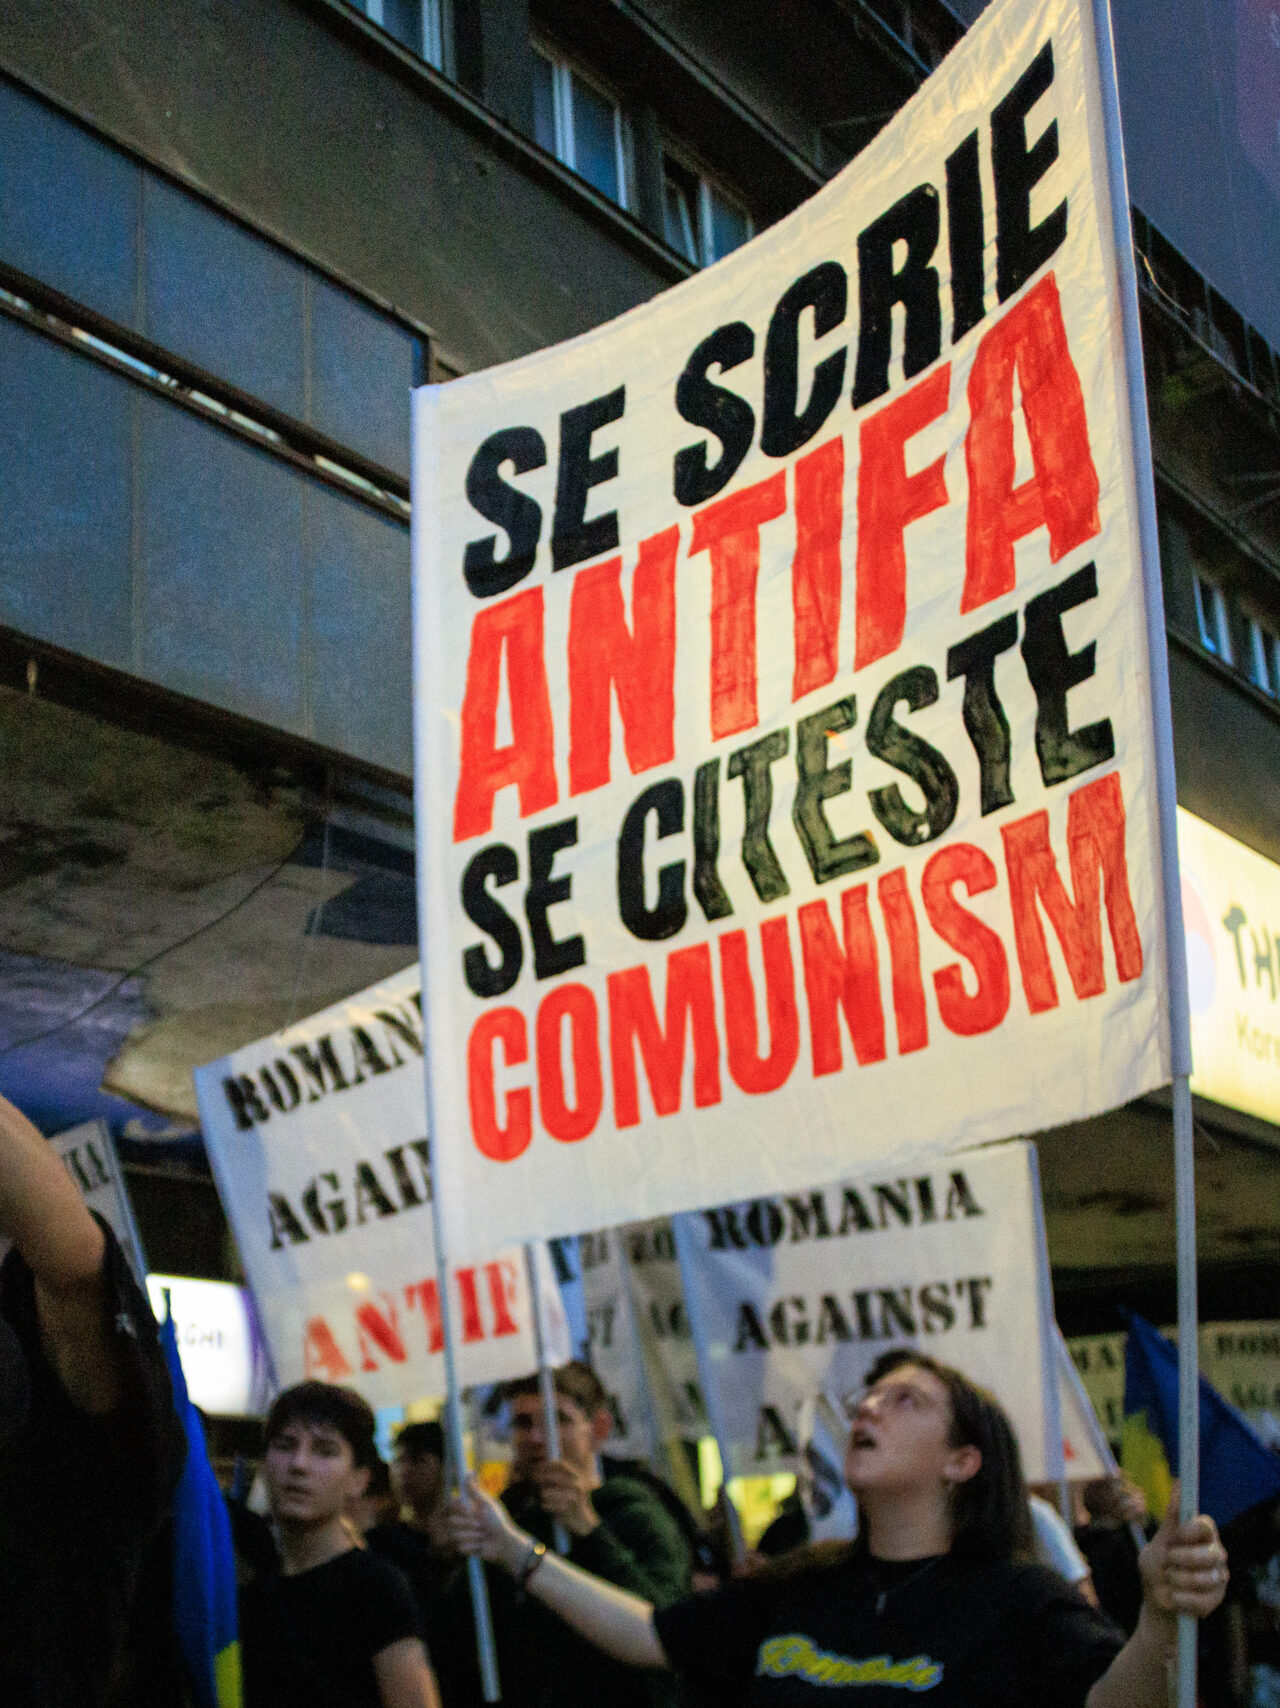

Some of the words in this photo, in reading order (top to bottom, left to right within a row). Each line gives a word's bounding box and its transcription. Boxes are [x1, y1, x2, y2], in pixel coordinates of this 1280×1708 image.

[463, 385, 625, 600] SE
[674, 39, 1067, 507] SCRIE
[454, 269, 1101, 843] ANTIFA
[461, 816, 586, 998] SE
[616, 561, 1116, 942] CITESTE
[224, 992, 423, 1132] ROMAN
[466, 771, 1144, 1163] COMUNISM
[303, 1258, 519, 1382] ANTIF
[704, 1170, 987, 1252] ROMANIA
[733, 1276, 992, 1354] AGAINST
